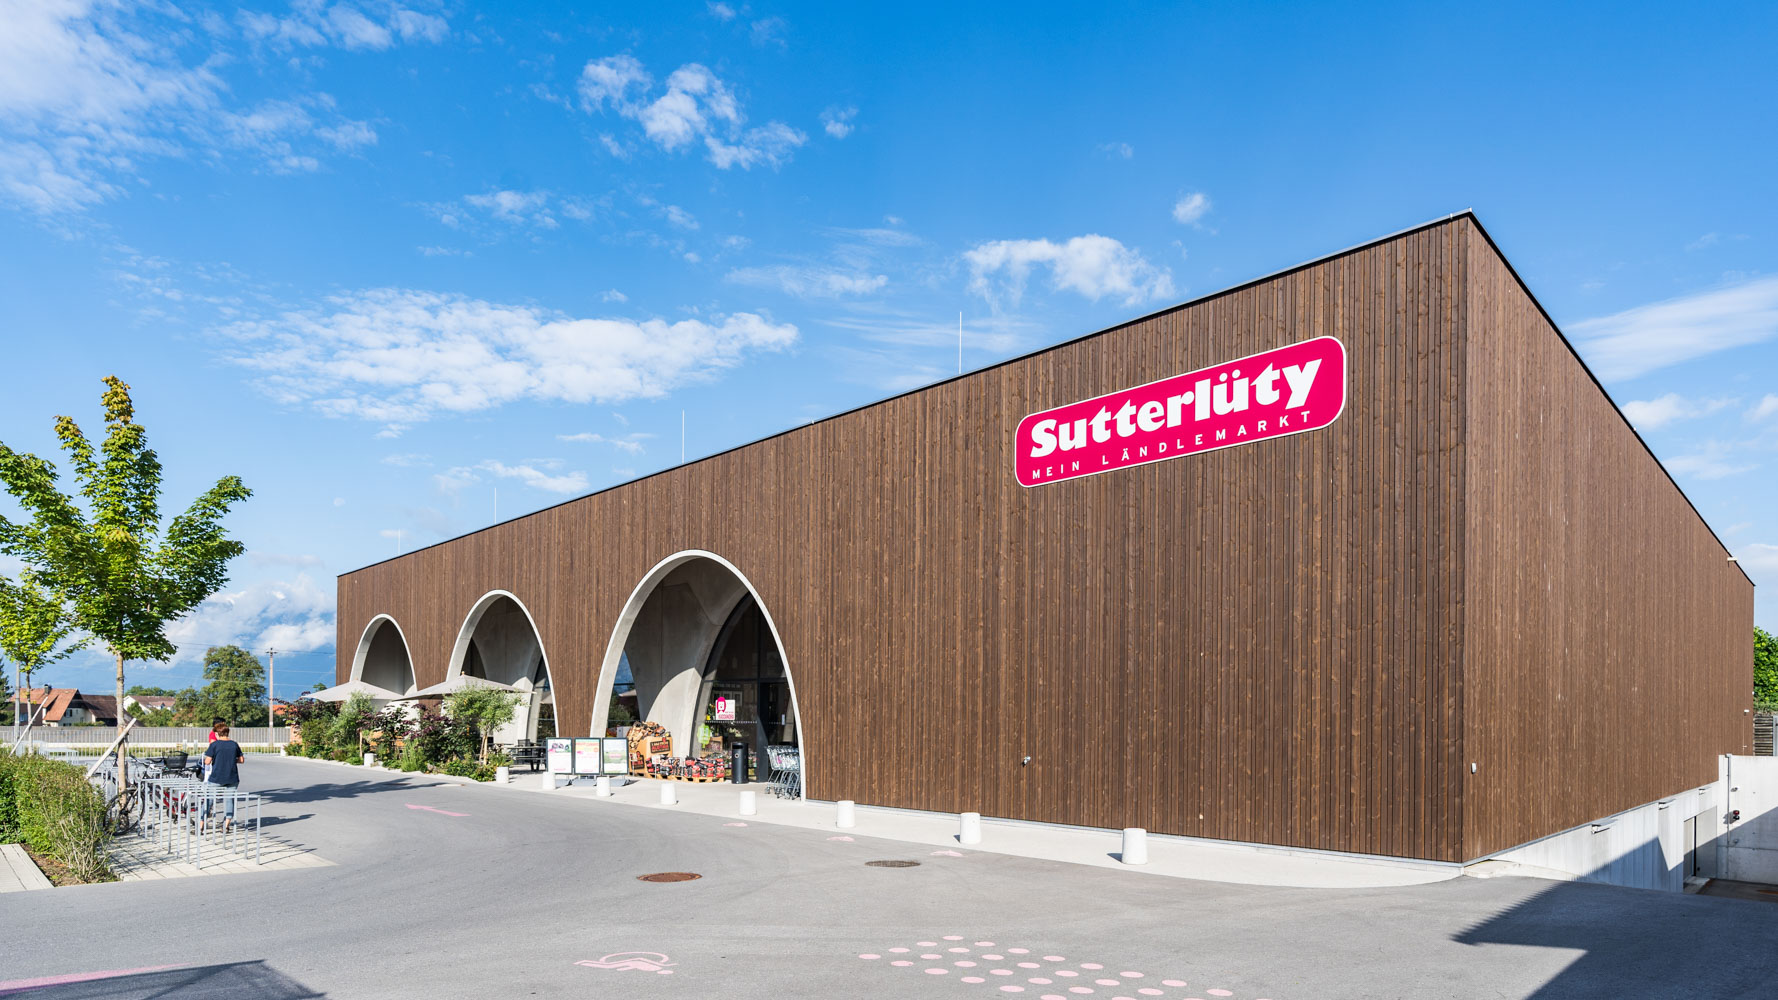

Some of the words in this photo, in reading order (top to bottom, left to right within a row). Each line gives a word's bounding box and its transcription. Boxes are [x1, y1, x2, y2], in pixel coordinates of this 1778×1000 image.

[1030, 358, 1323, 458] Sutterlüty
[1032, 460, 1080, 480] MEIN
[1102, 410, 1311, 466] LÄNDLEMARKT
